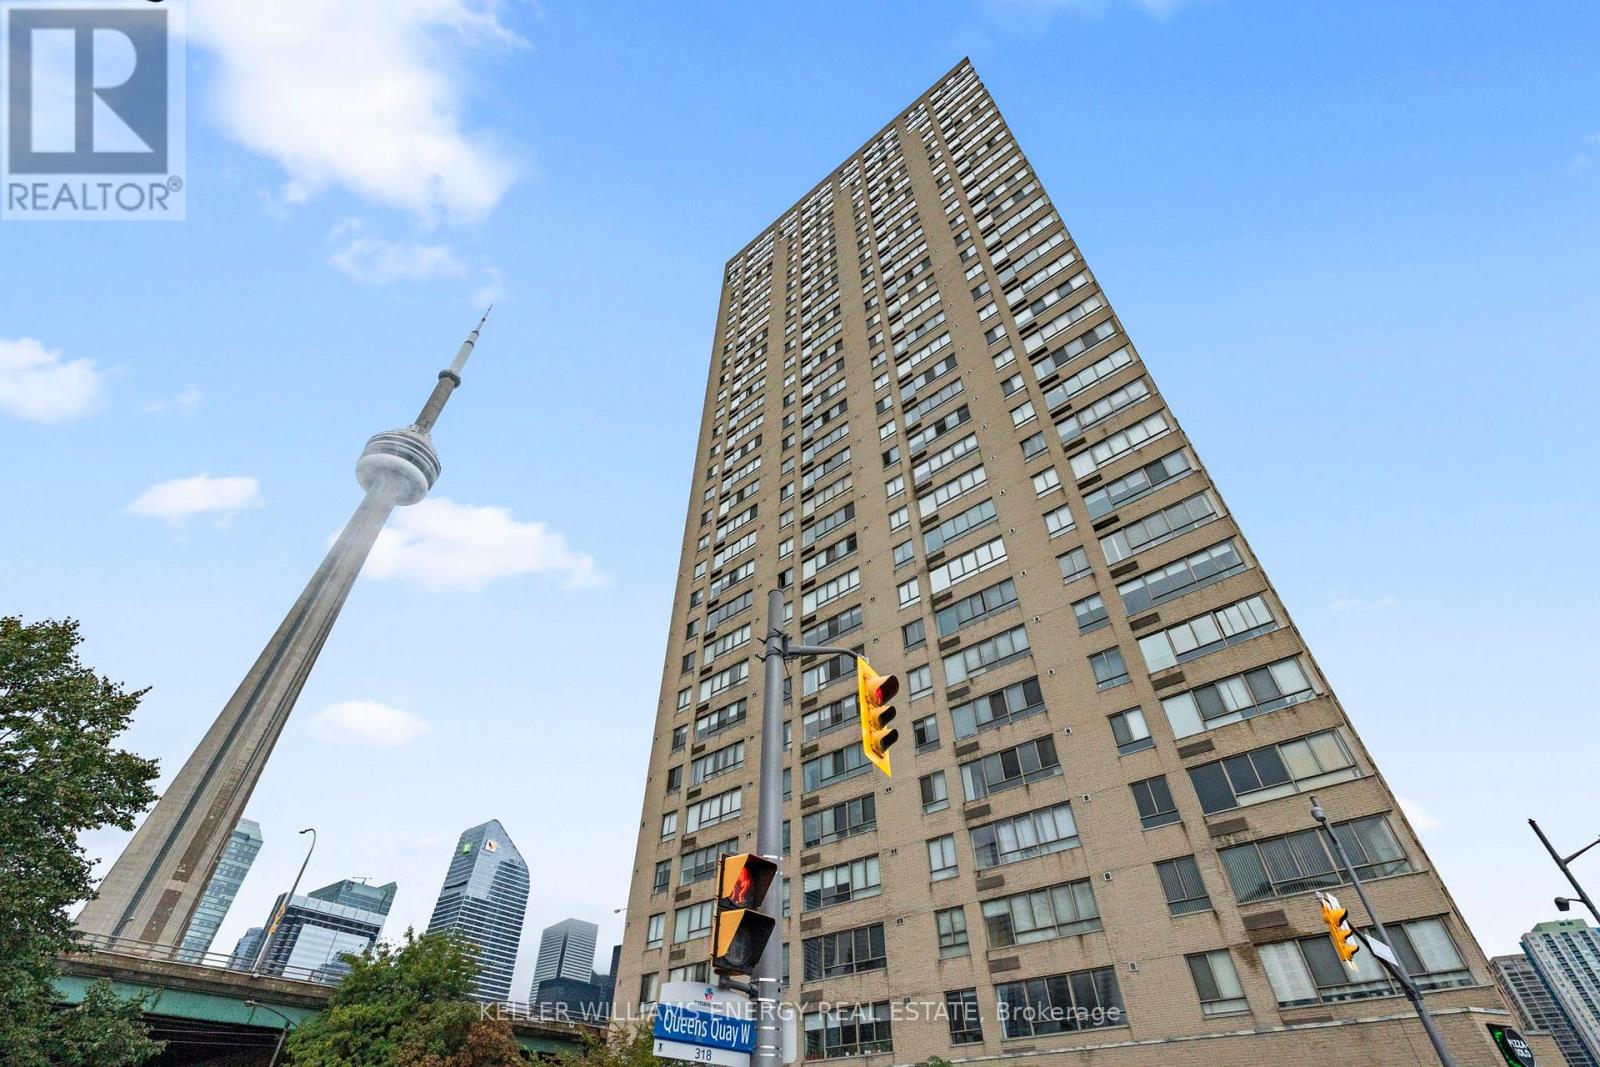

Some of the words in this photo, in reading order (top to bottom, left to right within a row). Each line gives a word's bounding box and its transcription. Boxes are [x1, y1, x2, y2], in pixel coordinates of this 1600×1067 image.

[663, 1008, 708, 1038] Queens
[710, 1018, 739, 1047] Quay
[741, 1023, 751, 1044] W
[694, 1047, 712, 1061] 318
